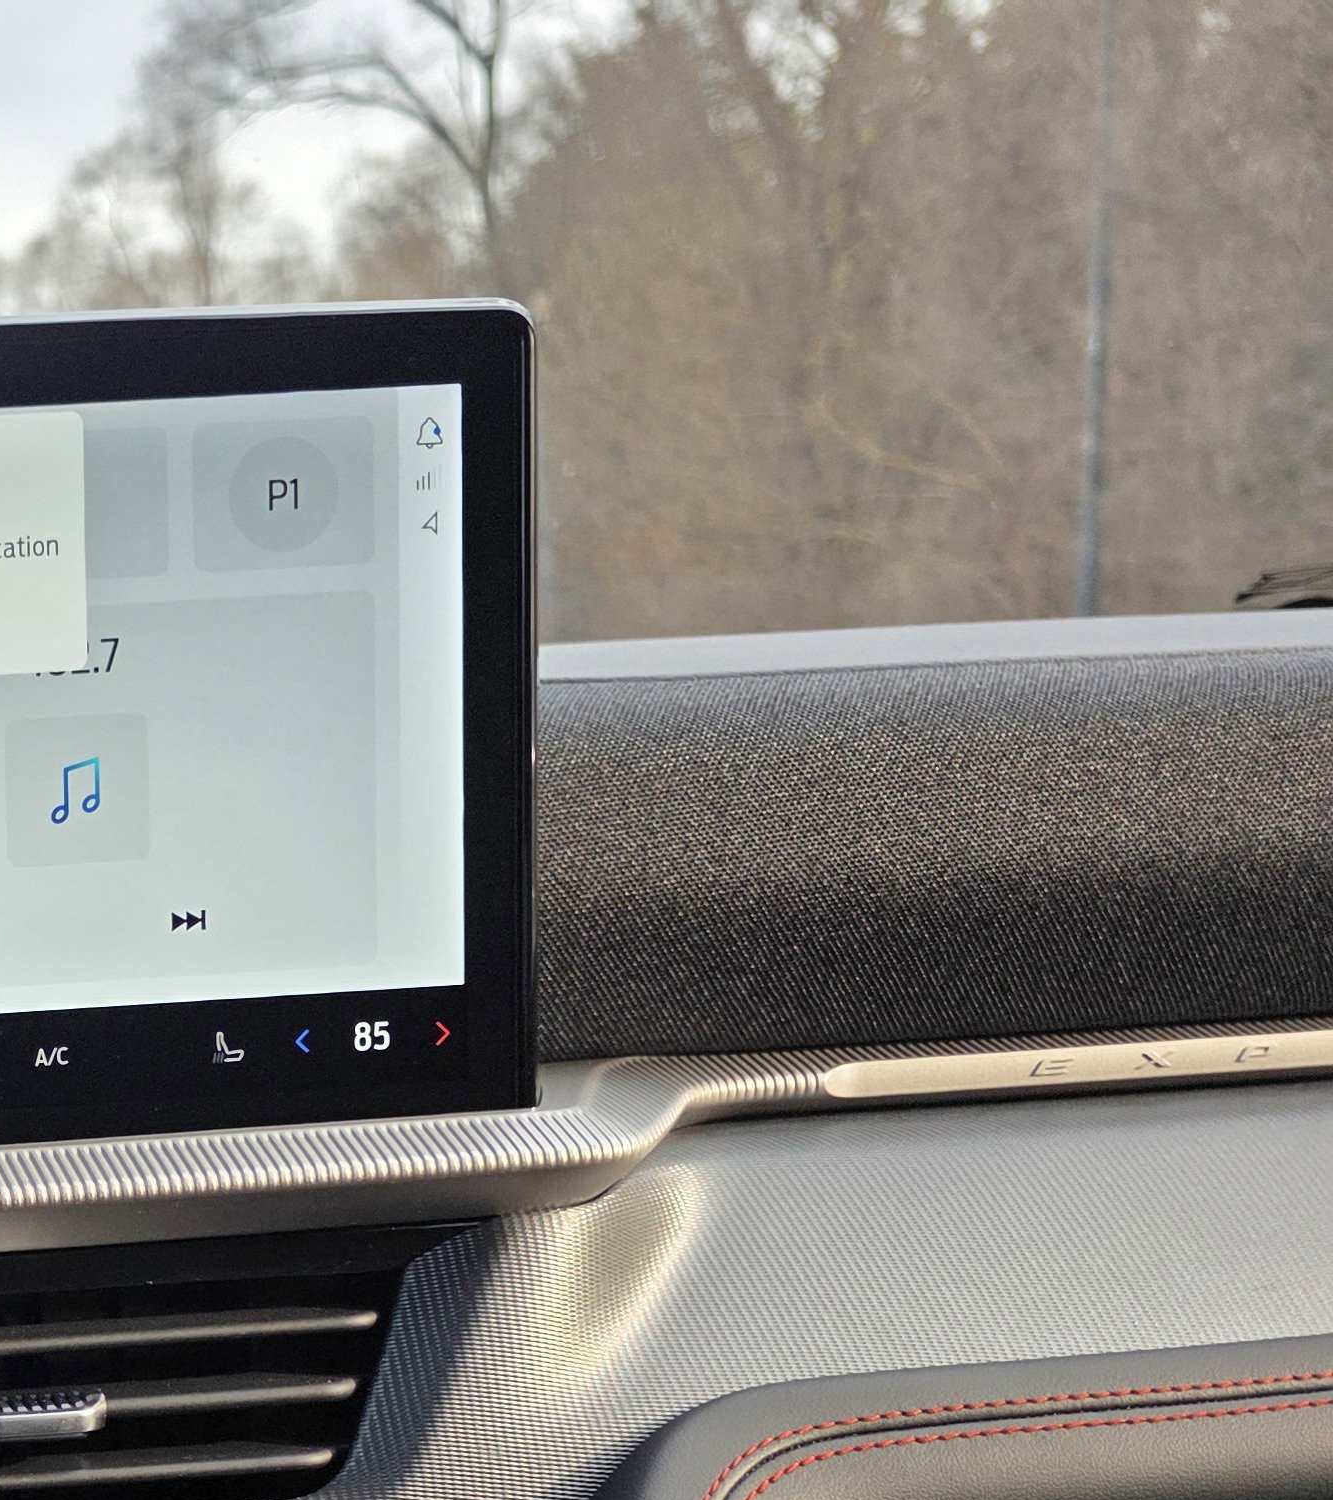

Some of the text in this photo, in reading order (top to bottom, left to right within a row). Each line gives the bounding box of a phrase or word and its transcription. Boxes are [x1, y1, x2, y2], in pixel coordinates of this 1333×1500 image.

[268, 478, 299, 512] P1
[353, 1020, 391, 1052] 85
[34, 1046, 69, 1067] A/C
